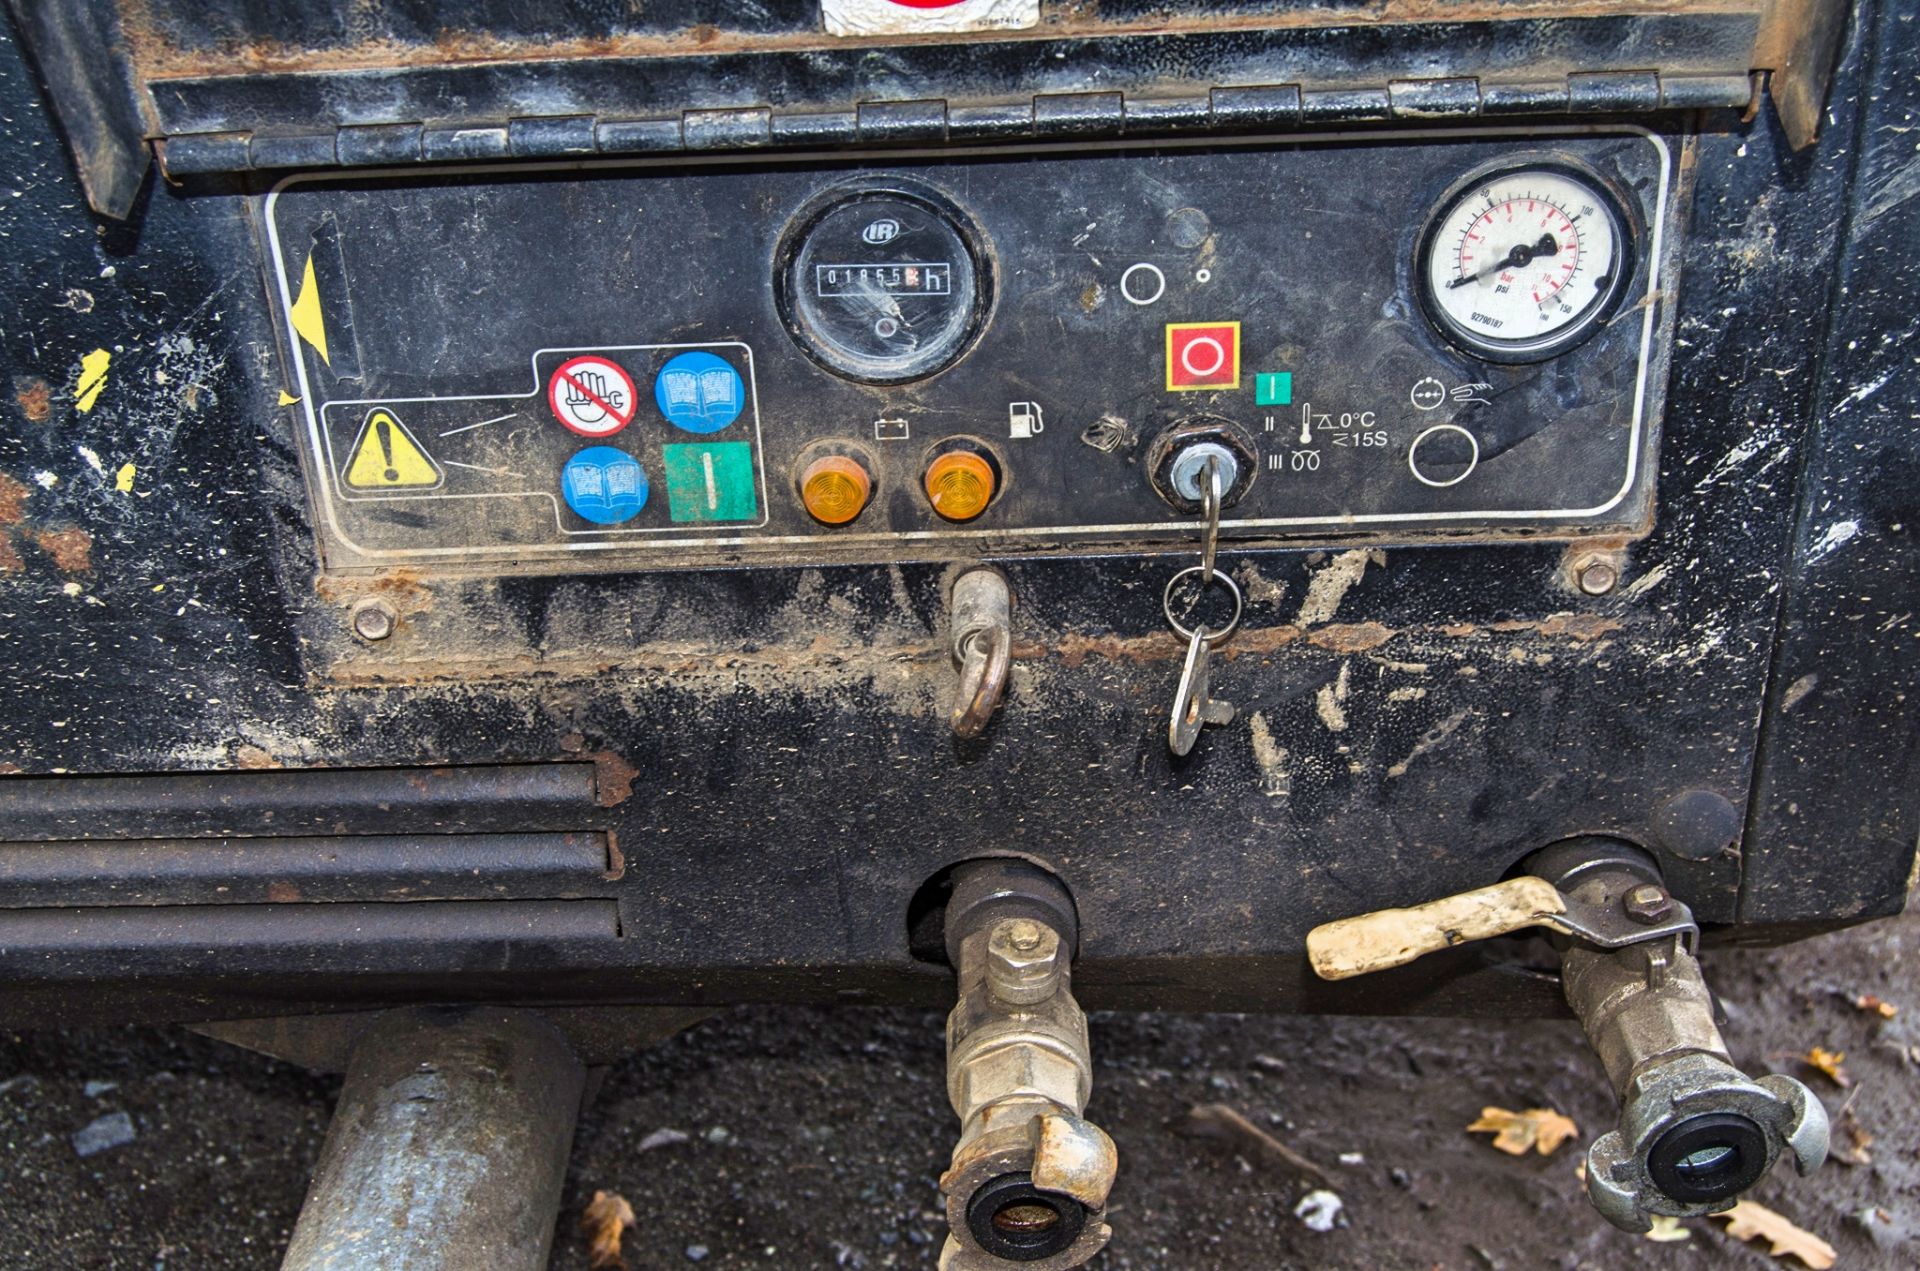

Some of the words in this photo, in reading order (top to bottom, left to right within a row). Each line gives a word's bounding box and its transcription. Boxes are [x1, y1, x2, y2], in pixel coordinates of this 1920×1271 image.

[1480, 188, 1490, 198] 50
[1581, 205, 1594, 216] 100
[869, 223, 893, 240] IR
[1479, 236, 1486, 245] 2
[925, 268, 940, 291] h
[1500, 271, 1515, 283] bar
[1542, 273, 1551, 283] 10
[1445, 280, 1451, 288] 0
[1494, 284, 1510, 294] psi
[1559, 303, 1573, 314] 150
[1470, 311, 1504, 329] 92790187
[1340, 411, 1376, 429] 0°C
